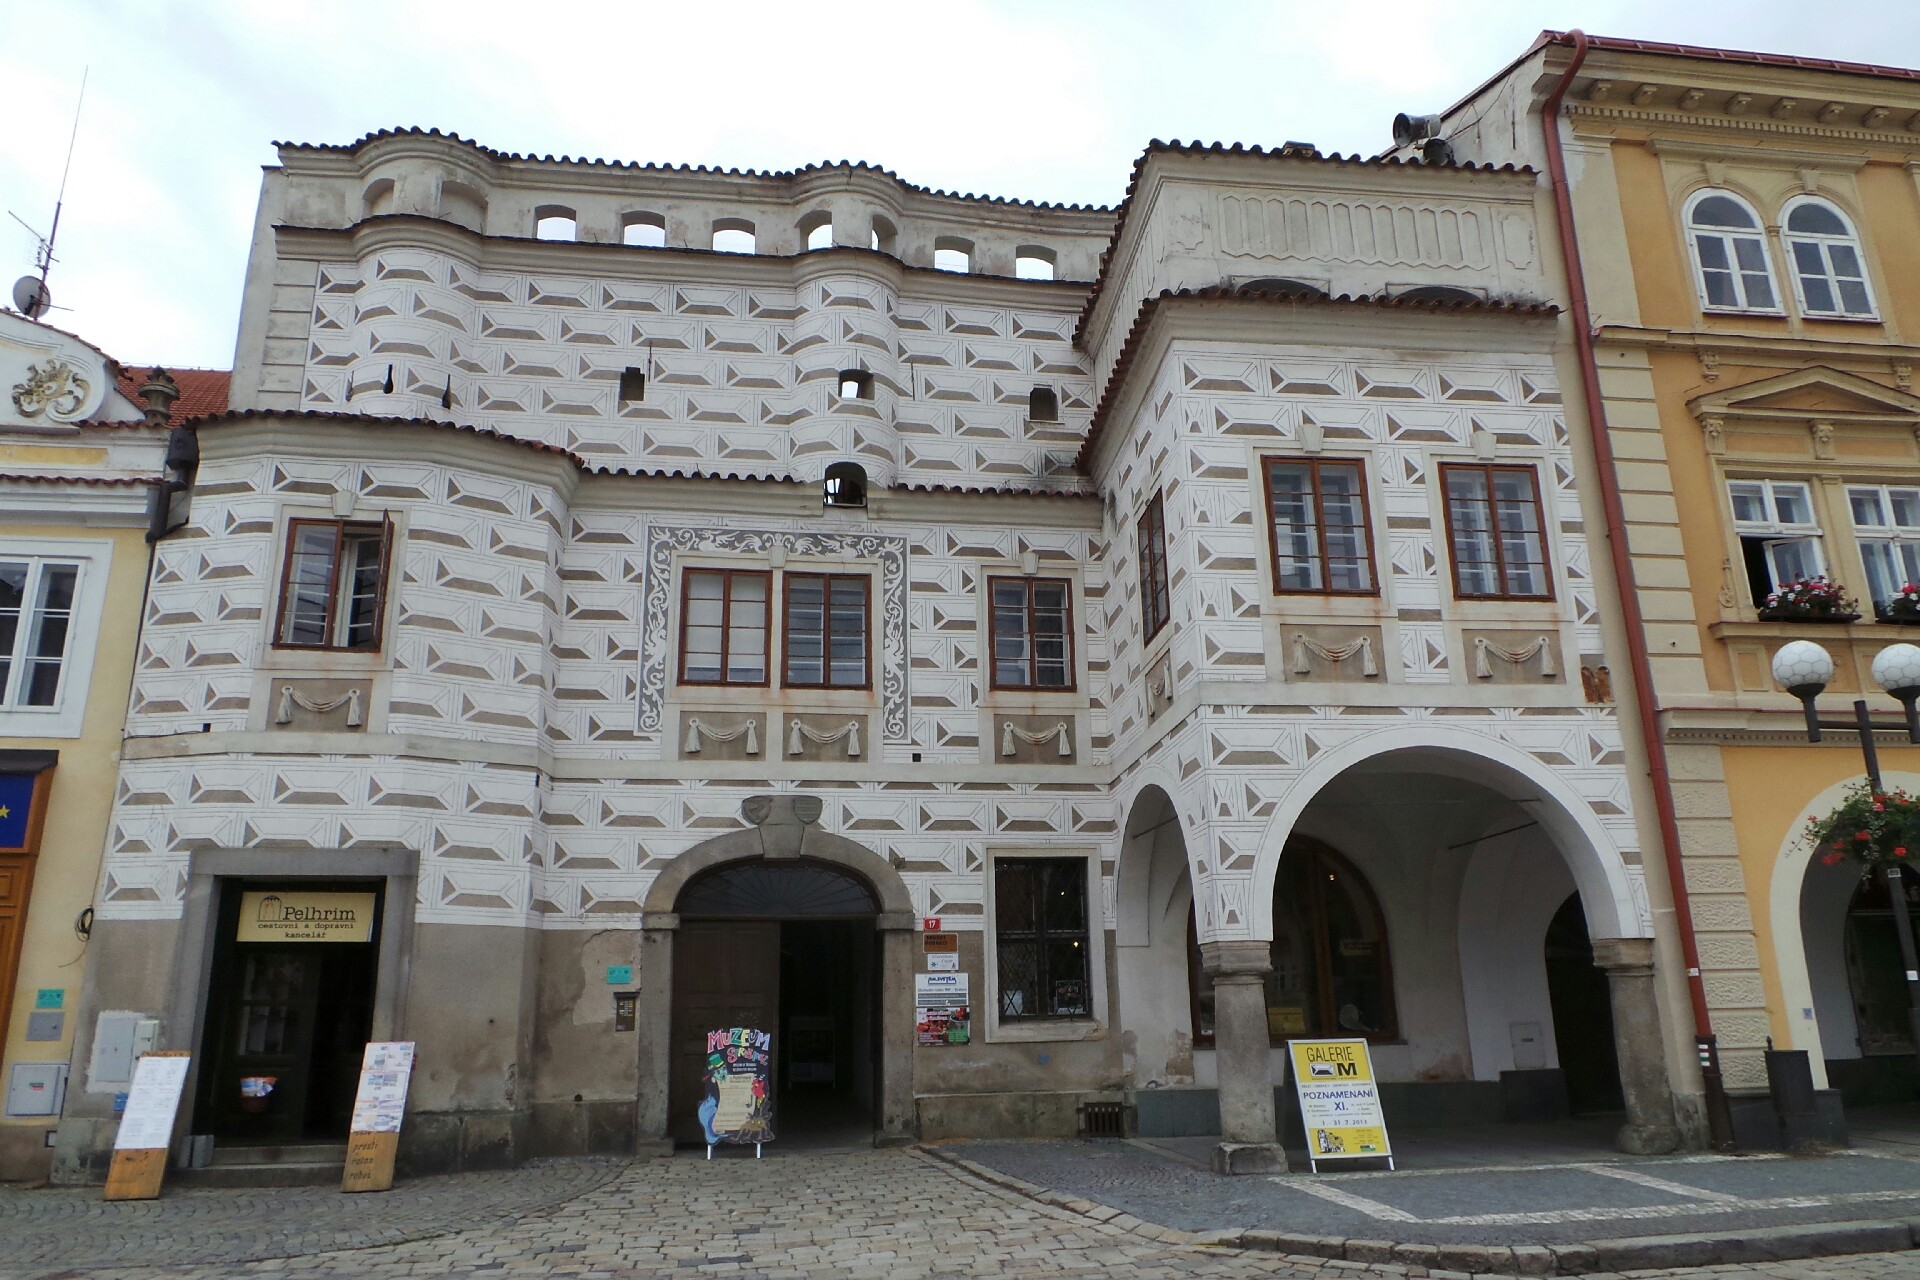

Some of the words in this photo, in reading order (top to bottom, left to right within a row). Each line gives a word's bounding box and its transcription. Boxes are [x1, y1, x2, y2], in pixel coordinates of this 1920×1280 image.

[282, 906, 356, 921] Pelhrim
[928, 920, 936, 929] 17
[707, 1027, 771, 1054] MUZEUM
[1306, 1046, 1354, 1063] GALERIE
[1336, 1062, 1358, 1076] M
[1302, 1088, 1374, 1100] POZNAMENANÍ
[1334, 1101, 1349, 1111] XI.
